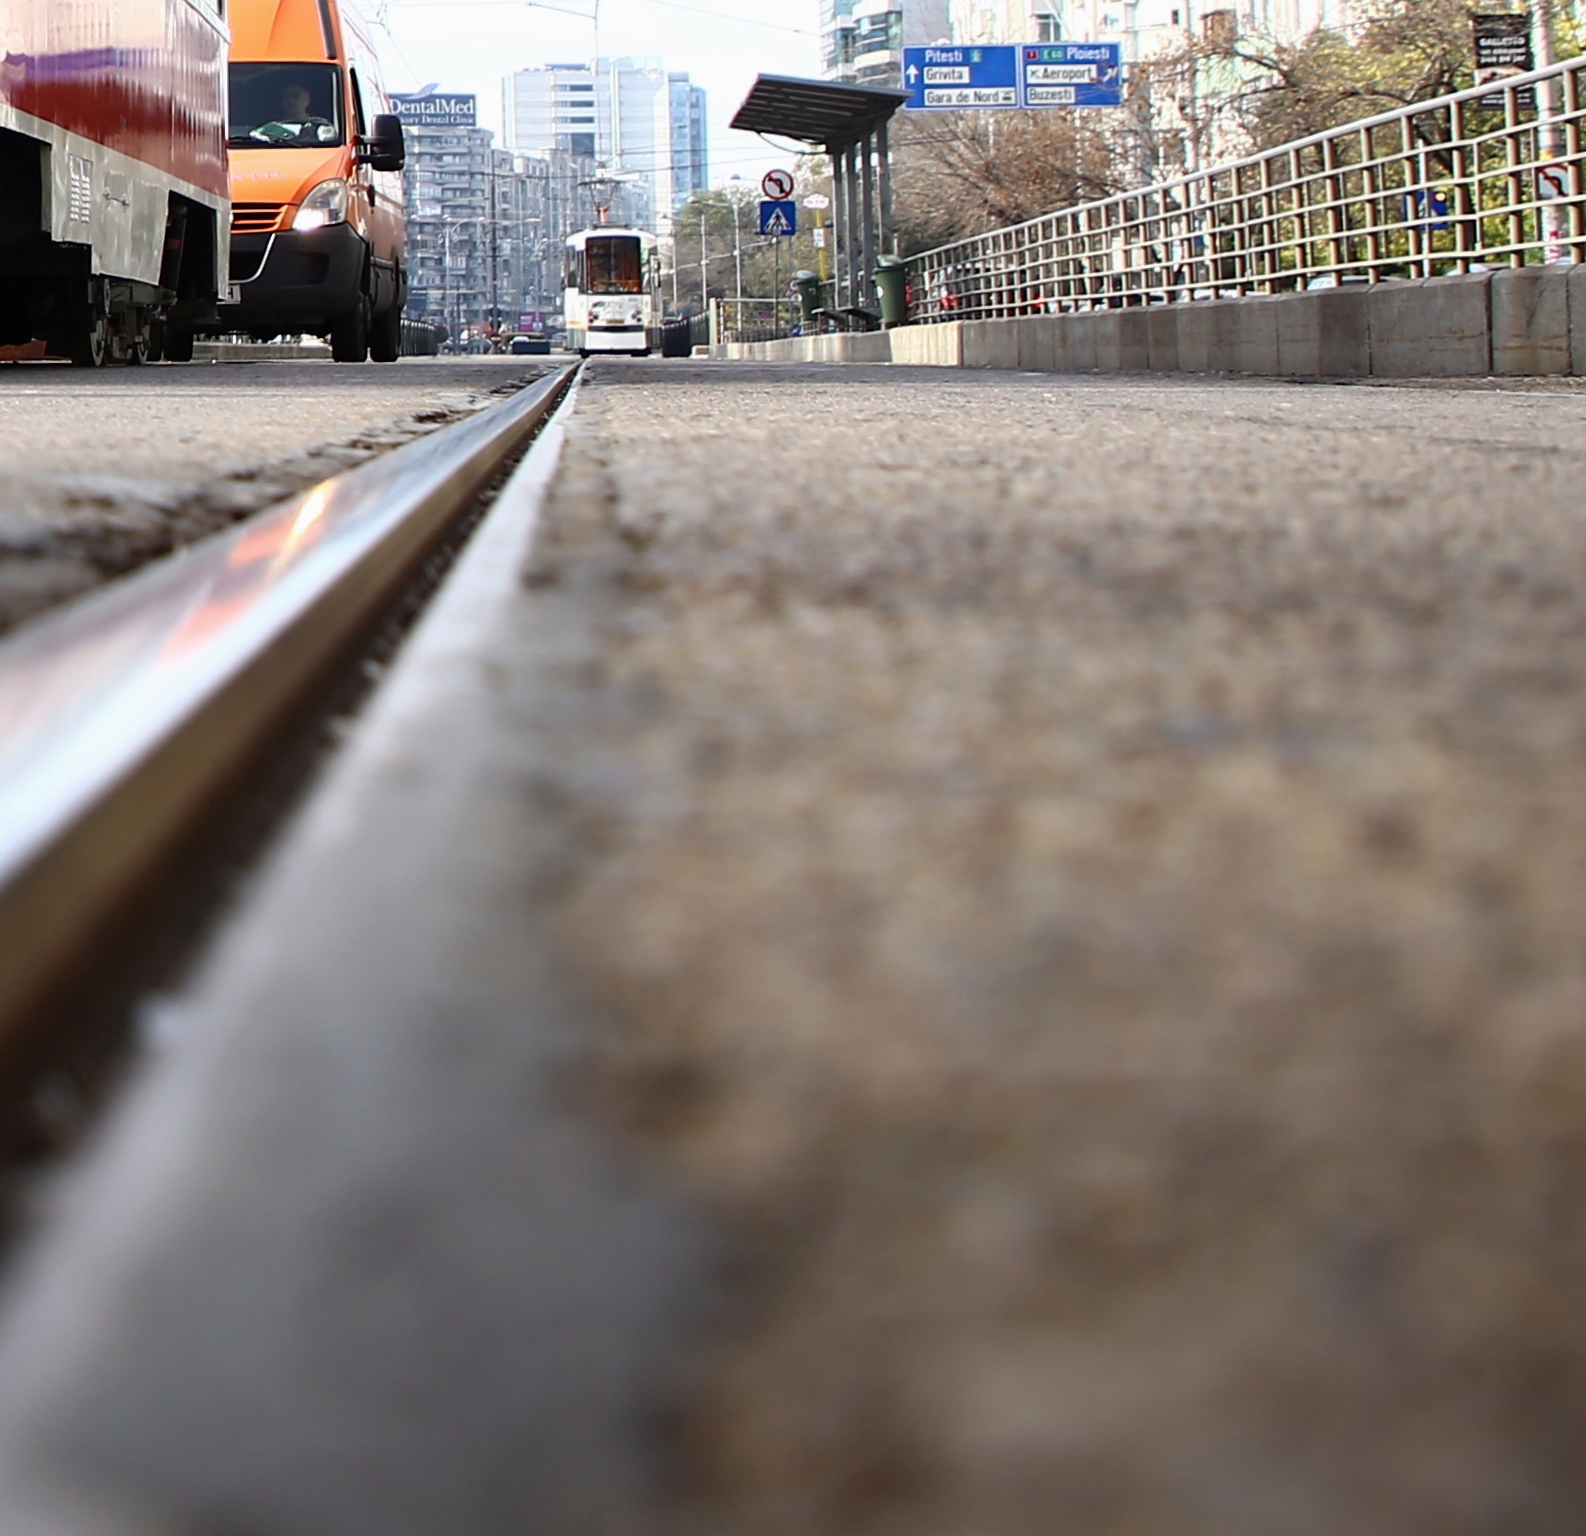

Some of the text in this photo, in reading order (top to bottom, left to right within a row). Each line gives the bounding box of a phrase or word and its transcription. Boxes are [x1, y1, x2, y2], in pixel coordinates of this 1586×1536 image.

[1042, 66, 1093, 81] Aeroport
[926, 89, 1000, 104] Gara de Nord
[389, 98, 475, 114] DentalMed
[422, 115, 450, 124] Dental
[450, 115, 475, 124] Clinic
